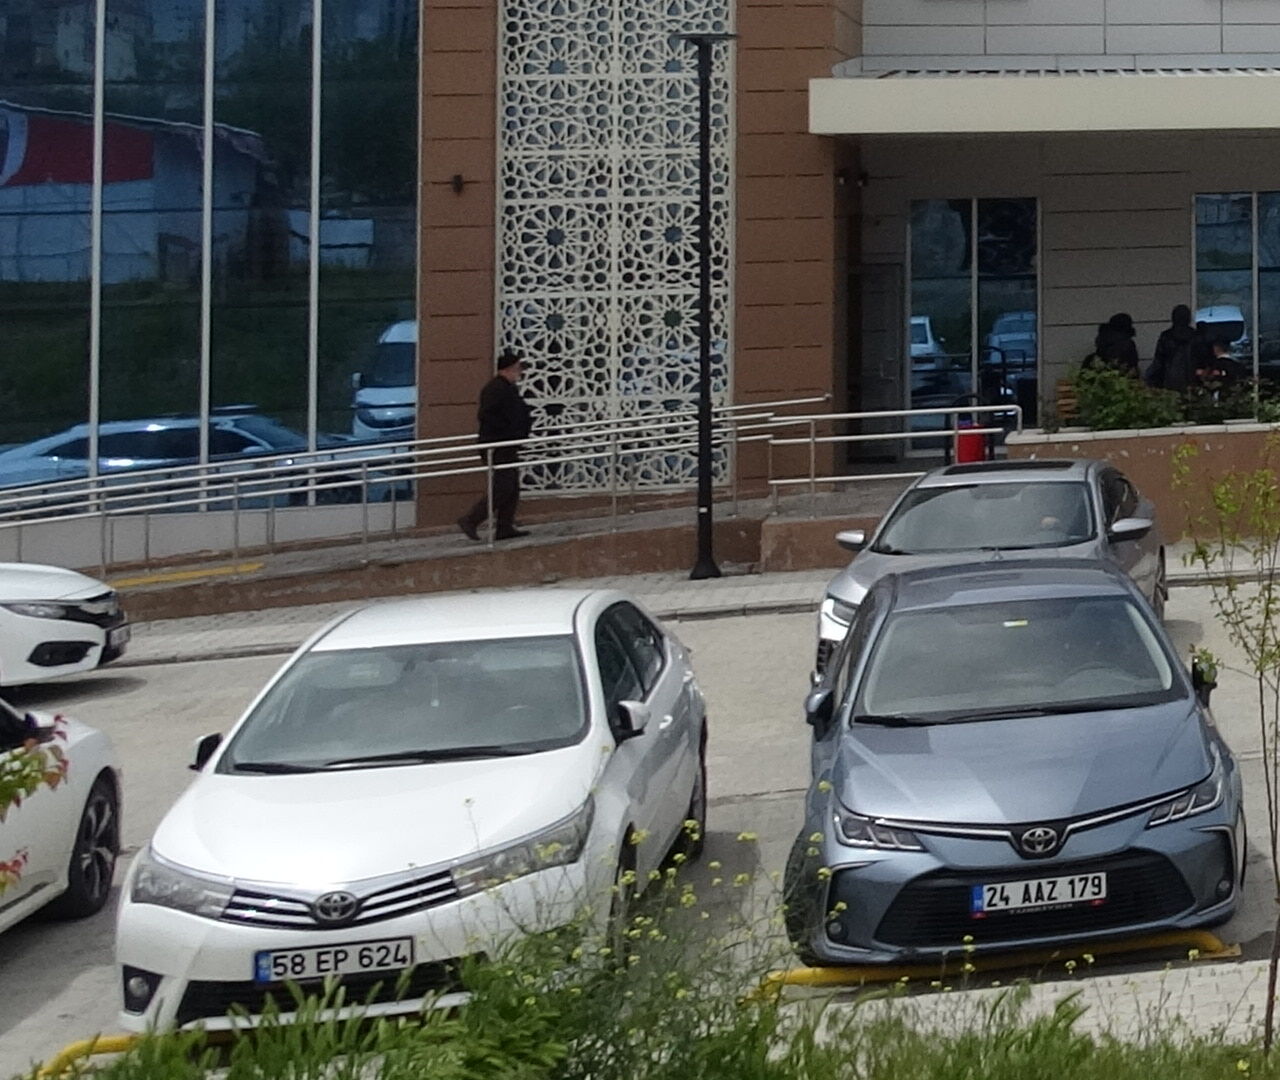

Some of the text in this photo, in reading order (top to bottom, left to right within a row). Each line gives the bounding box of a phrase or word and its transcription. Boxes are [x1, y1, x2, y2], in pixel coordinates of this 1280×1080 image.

[986, 875, 1102, 908] 24 AAZ 179
[272, 943, 408, 976] 58 EP 624
